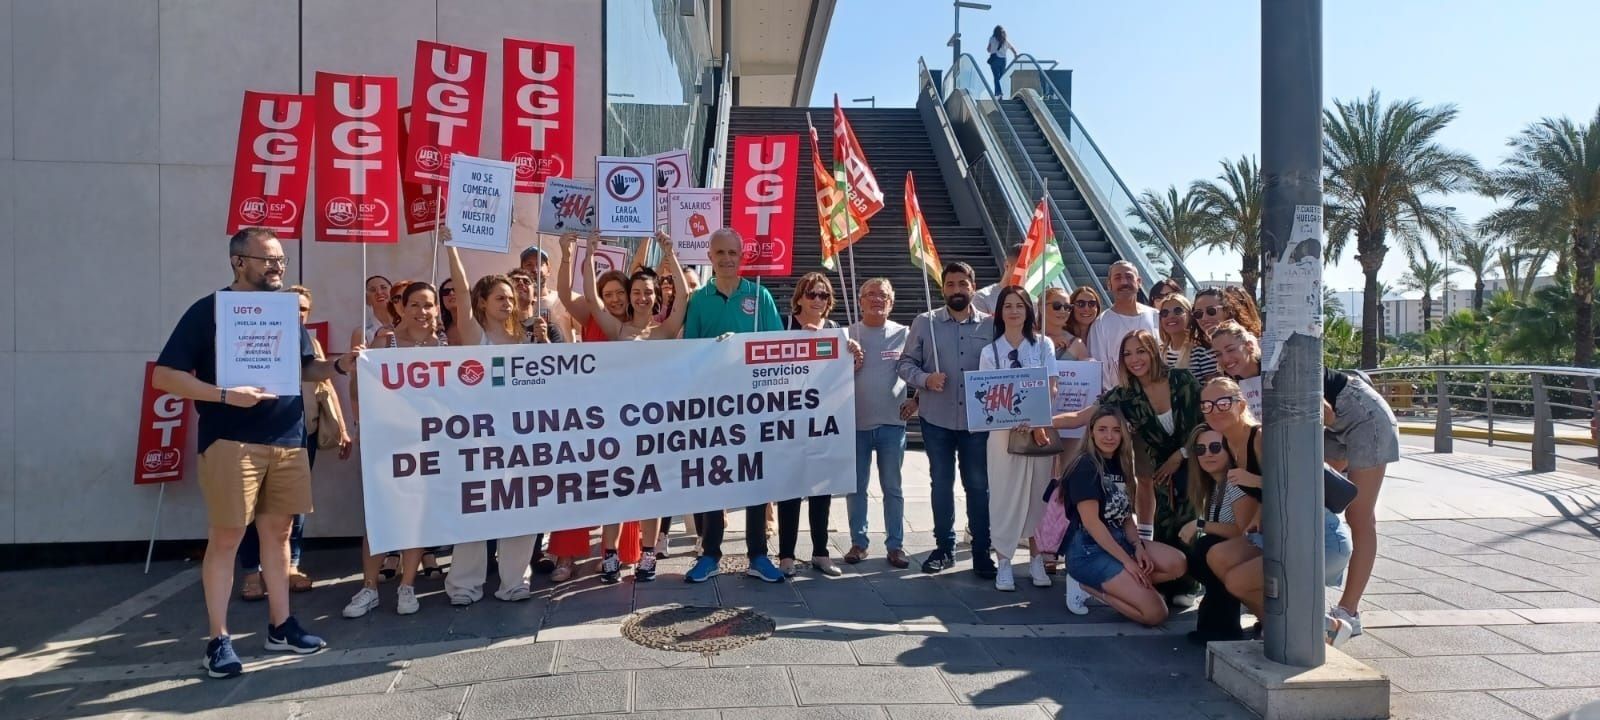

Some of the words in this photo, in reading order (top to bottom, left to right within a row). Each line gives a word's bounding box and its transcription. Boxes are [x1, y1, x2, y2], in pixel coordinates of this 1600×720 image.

[426, 48, 473, 147] UGT
[516, 47, 560, 151] UGT
[331, 82, 383, 195] UGT
[251, 99, 302, 196] UGT
[471, 171, 482, 182] NO
[483, 173, 494, 184] SE
[462, 183, 501, 198] COMERCIA
[745, 142, 786, 236] UGT
[472, 198, 488, 209] CON
[615, 206, 638, 214] CARGA
[680, 201, 711, 210] SALARIOS
[462, 210, 496, 223] NUESTRO
[612, 215, 642, 224] LABORAL
[462, 223, 494, 236] SALARIO
[678, 240, 710, 250] REBAJADO
[233, 306, 254, 315] UGT
[751, 342, 811, 361] CCOO
[511, 354, 597, 378] FeSMC
[752, 363, 810, 378] servicios
[381, 360, 452, 390] UGT
[511, 377, 547, 387] Granada
[752, 377, 790, 389] granada
[152, 393, 184, 448] GT
[421, 413, 496, 442] POR
[512, 406, 606, 435] UNAS
[619, 388, 821, 427] CONDICIONES
[392, 450, 442, 478] DE
[458, 436, 621, 472] TRABAJO
[636, 423, 747, 457] DIGNAS
[760, 419, 796, 443] EN
[809, 415, 841, 438] LA
[461, 463, 663, 515] EMPRESA
[681, 451, 765, 489] H&M
